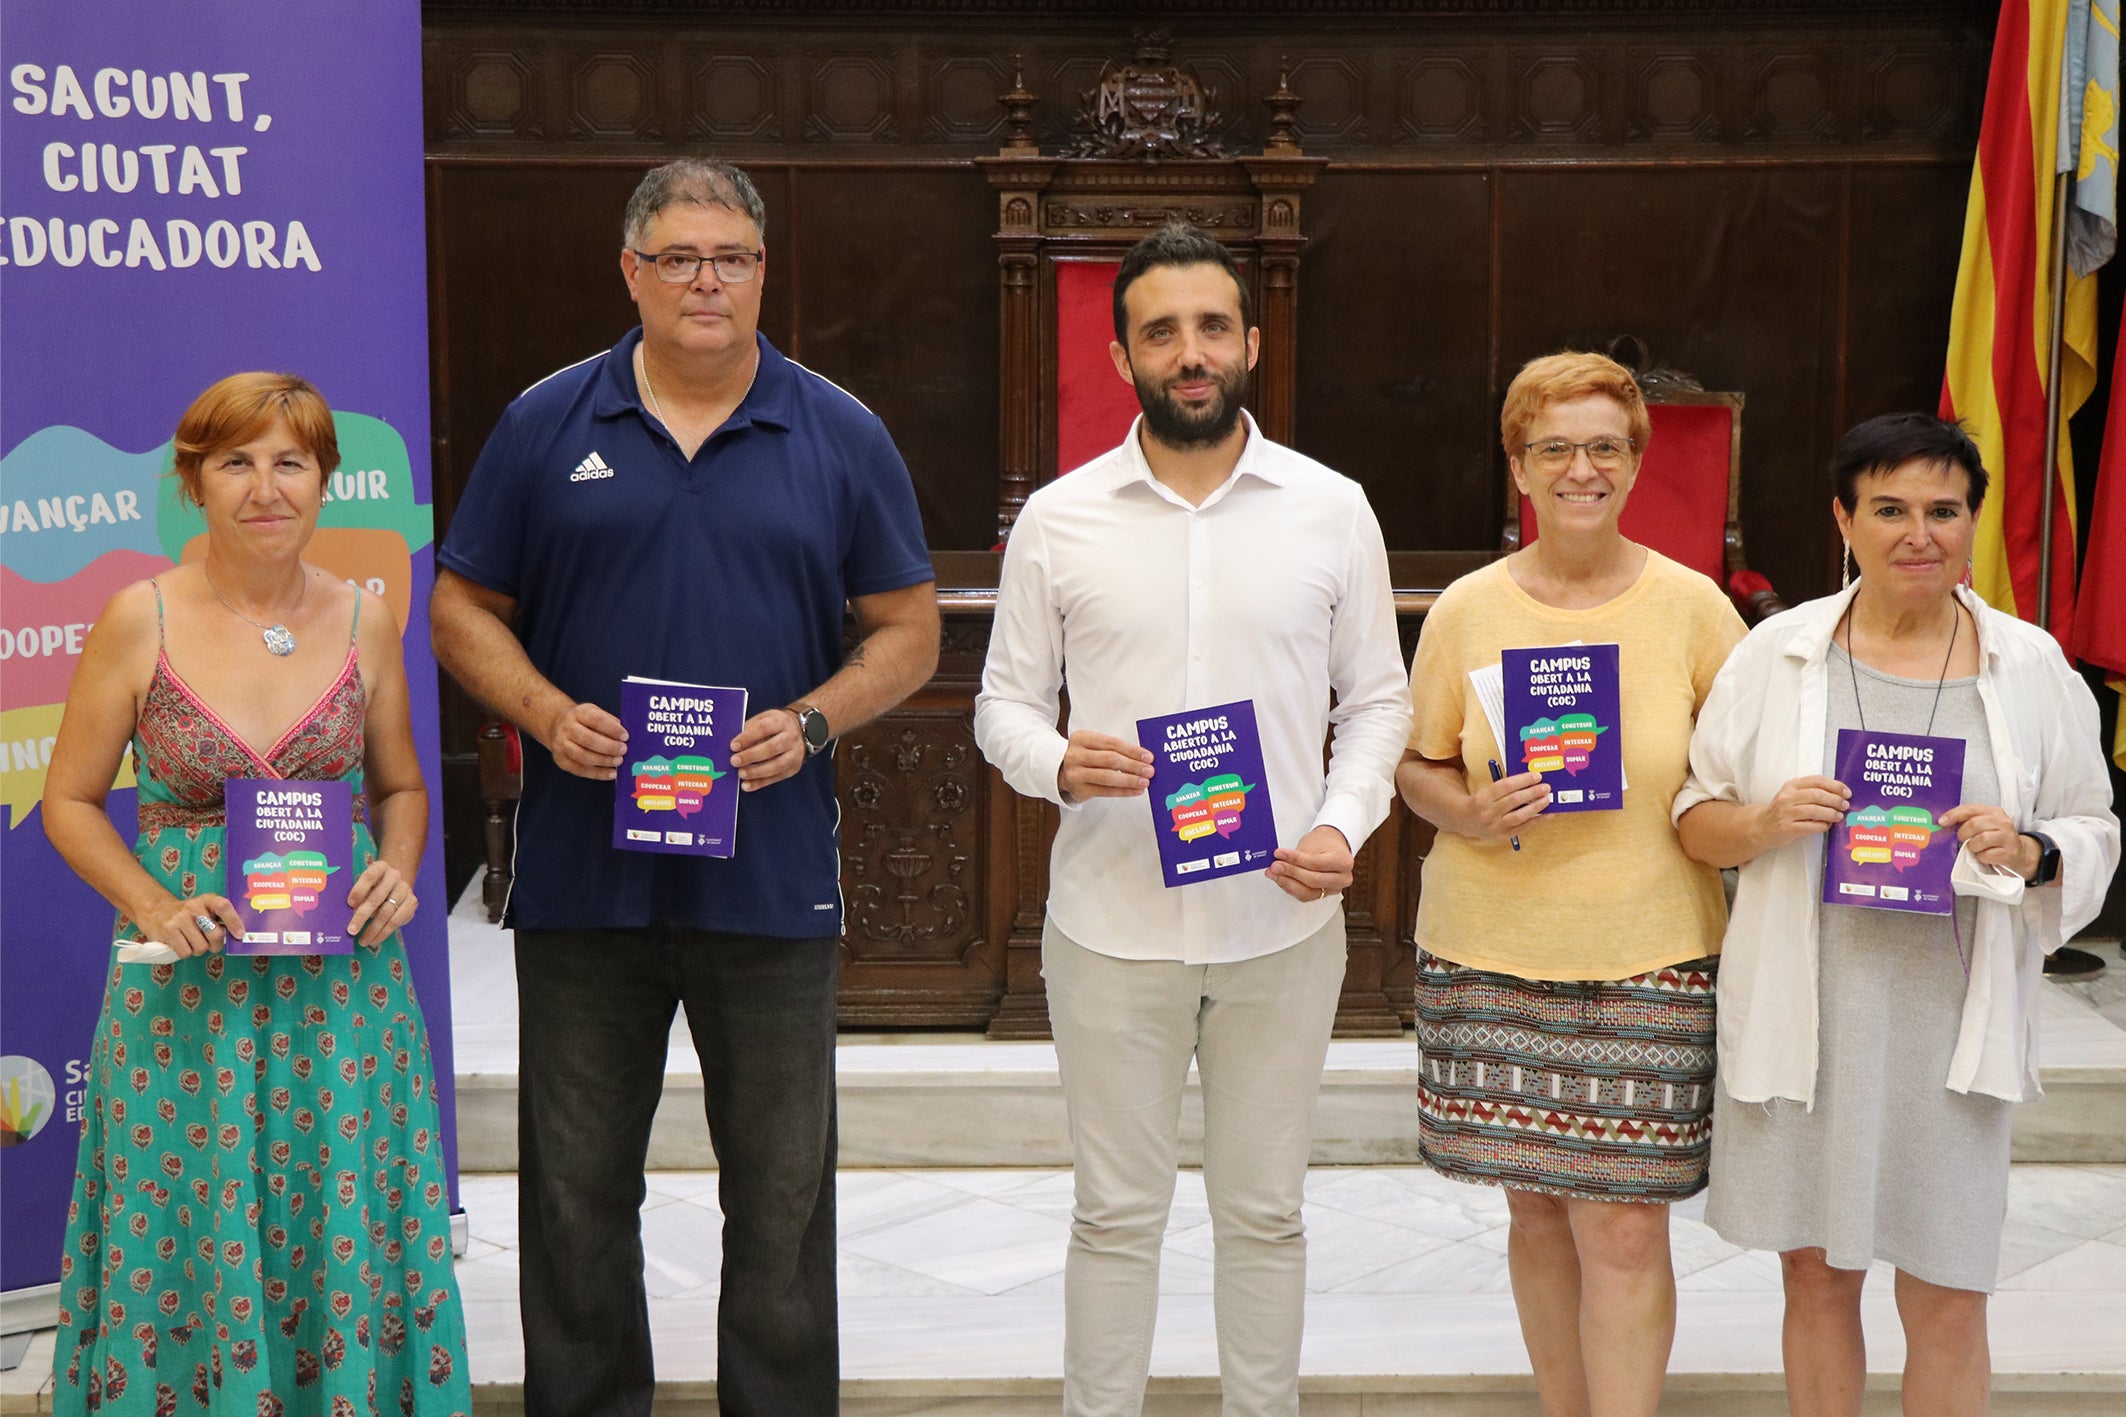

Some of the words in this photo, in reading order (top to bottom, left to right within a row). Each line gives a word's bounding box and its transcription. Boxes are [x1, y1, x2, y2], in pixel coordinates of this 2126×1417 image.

[11, 64, 271, 131] SAGUNT,
[44, 142, 247, 198] CIUTAT
[570, 468, 614, 482] adidas
[1530, 657, 1590, 673] CAMPUS
[1531, 673, 1563, 684] OBERT
[1567, 673, 1574, 682] A
[1577, 672, 1591, 681] LA
[1531, 683, 1592, 696] CIUTADANIA
[650, 696, 714, 713] CAMPUS
[1548, 695, 1576, 708] (COC)
[649, 712, 683, 724] OBERT
[687, 714, 694, 723] A
[699, 714, 713, 724] LA
[648, 723, 713, 737] CIUTADANIA
[1166, 715, 1229, 739] CAMPUS
[665, 736, 695, 748] (COC)
[1164, 735, 1208, 753] ABIERTO
[1211, 734, 1220, 745] A
[1221, 730, 1237, 742] LA
[1866, 744, 1934, 762] CAMPUS
[1190, 758, 1219, 772] (COC)
[1865, 759, 1902, 772] OBERT
[1905, 763, 1913, 774] A
[1917, 764, 1932, 775] LA
[1864, 771, 1932, 787] CIUTADANIA
[1881, 785, 1913, 798] (COC)
[256, 791, 322, 807] CAMPUS
[256, 807, 292, 818] OBERT
[295, 808, 304, 818] A
[307, 808, 322, 818] LA
[256, 818, 324, 831] CIUTADANIA
[274, 831, 306, 843] (COC)
